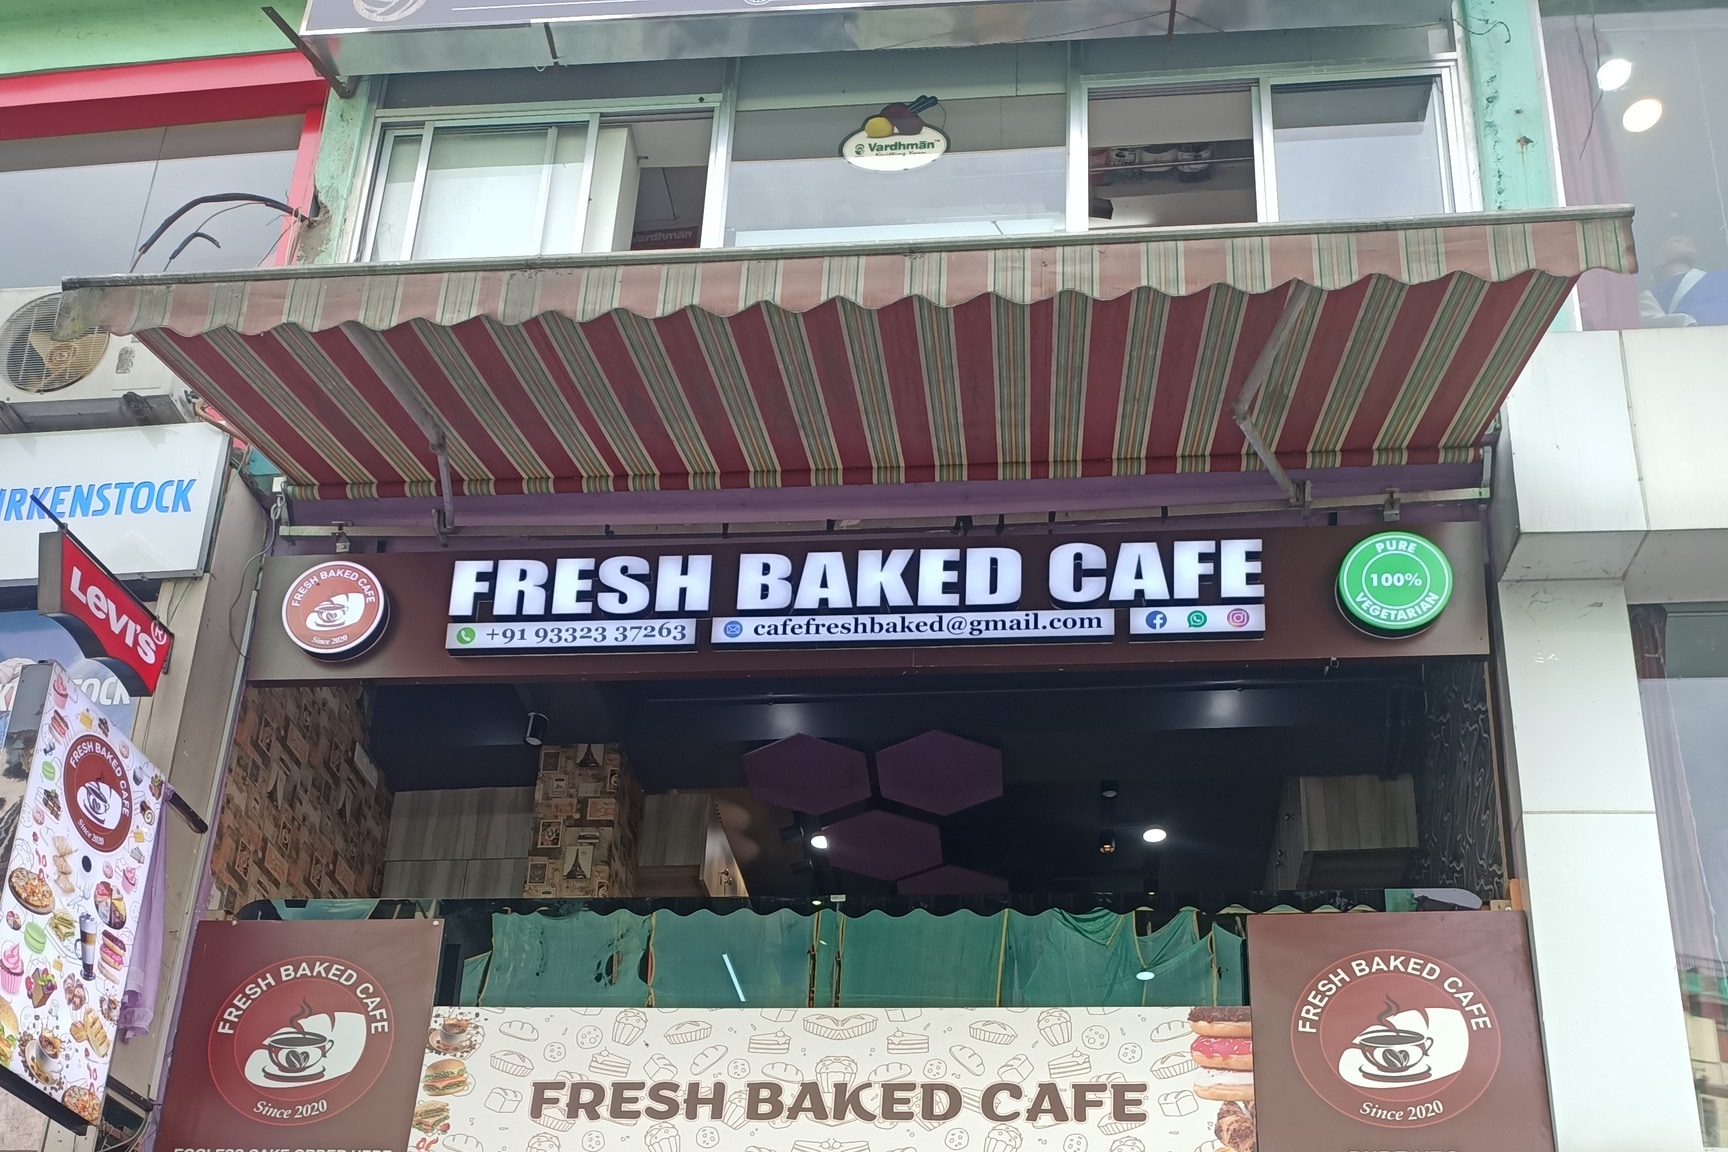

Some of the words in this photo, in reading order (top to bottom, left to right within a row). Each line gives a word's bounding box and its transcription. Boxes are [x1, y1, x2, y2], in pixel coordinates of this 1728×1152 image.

[1375, 540, 1417, 553] PURE
[291, 576, 319, 607] FRESH
[319, 569, 358, 581] BAKED
[357, 578, 376, 604] CAFE
[448, 555, 713, 617] FRESH
[736, 546, 1022, 611] BAKED
[1048, 539, 1265, 603] CAFE
[1370, 573, 1422, 587] 100%
[1355, 592, 1439, 620] VEGETARIAN
[486, 626, 527, 645] +91
[535, 624, 607, 644] 93323
[614, 622, 687, 643] 37263
[753, 613, 1103, 637] cafefreshbaked@gmail.com
[311, 636, 331, 645] Since
[331, 634, 348, 645] 2020
[69, 741, 94, 769] FRESH
[95, 742, 122, 777] BAKED
[119, 780, 130, 818] CAFE
[78, 818, 92, 838] Since
[217, 973, 276, 1035] FRESH
[279, 961, 357, 986] BAKED
[356, 982, 389, 1035] CAFE
[1298, 967, 1350, 1033] FRESH
[1350, 955, 1441, 981] BAKED
[1443, 976, 1492, 1031] CAFE
[253, 1100, 292, 1119] Since
[293, 1099, 328, 1119] 2020
[531, 1081, 726, 1121] FRESH
[746, 1082, 963, 1122] BAKED
[981, 1082, 1147, 1123] CAFE
[1359, 1101, 1404, 1120] Since
[1407, 1100, 1444, 1121] 2020
